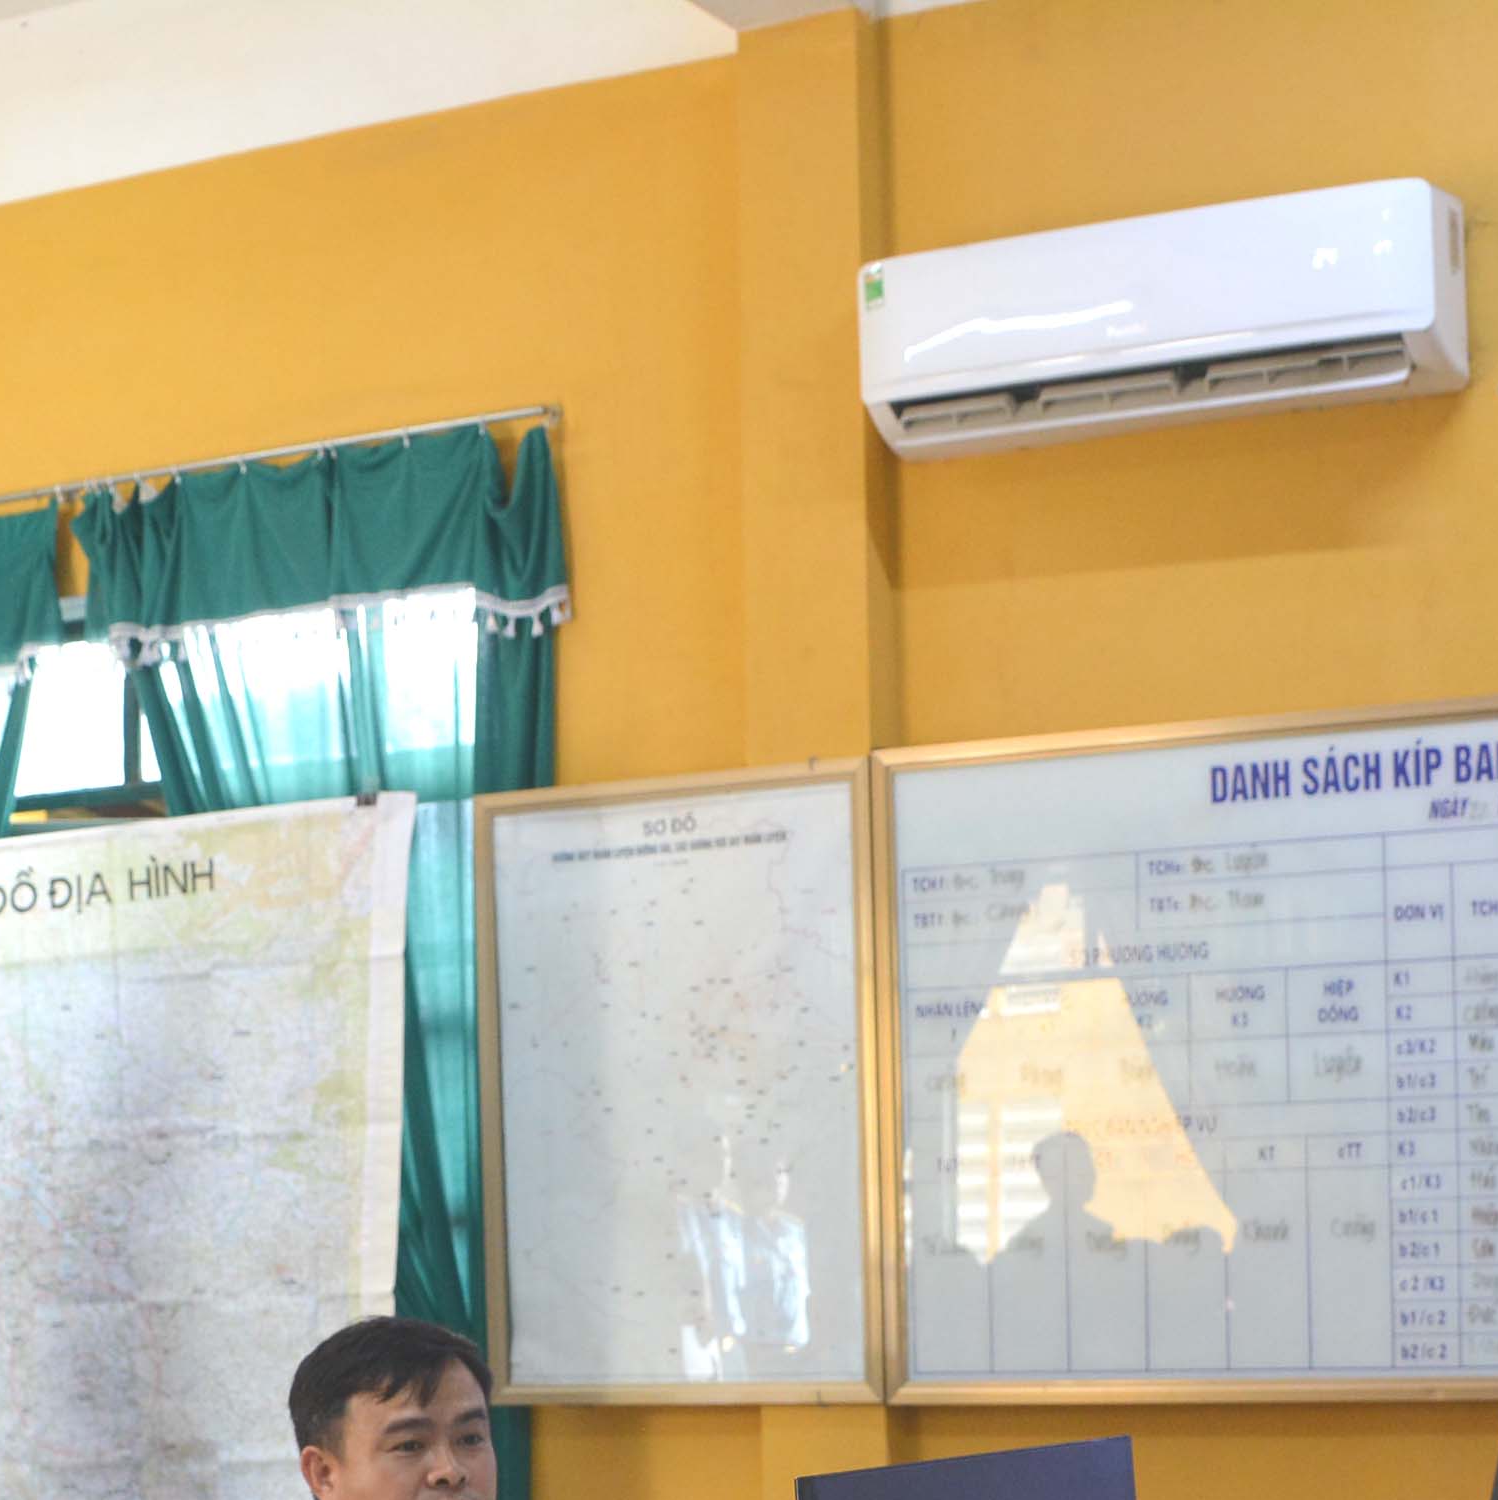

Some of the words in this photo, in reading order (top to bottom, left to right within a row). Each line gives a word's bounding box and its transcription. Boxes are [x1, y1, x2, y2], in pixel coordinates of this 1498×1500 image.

[1211, 759, 1291, 804] DANH
[1301, 747, 1382, 797] SÁCH
[1392, 739, 1442, 789] KÍP
[48, 872, 114, 917] ĐỊA
[127, 854, 216, 901] HÌNH
